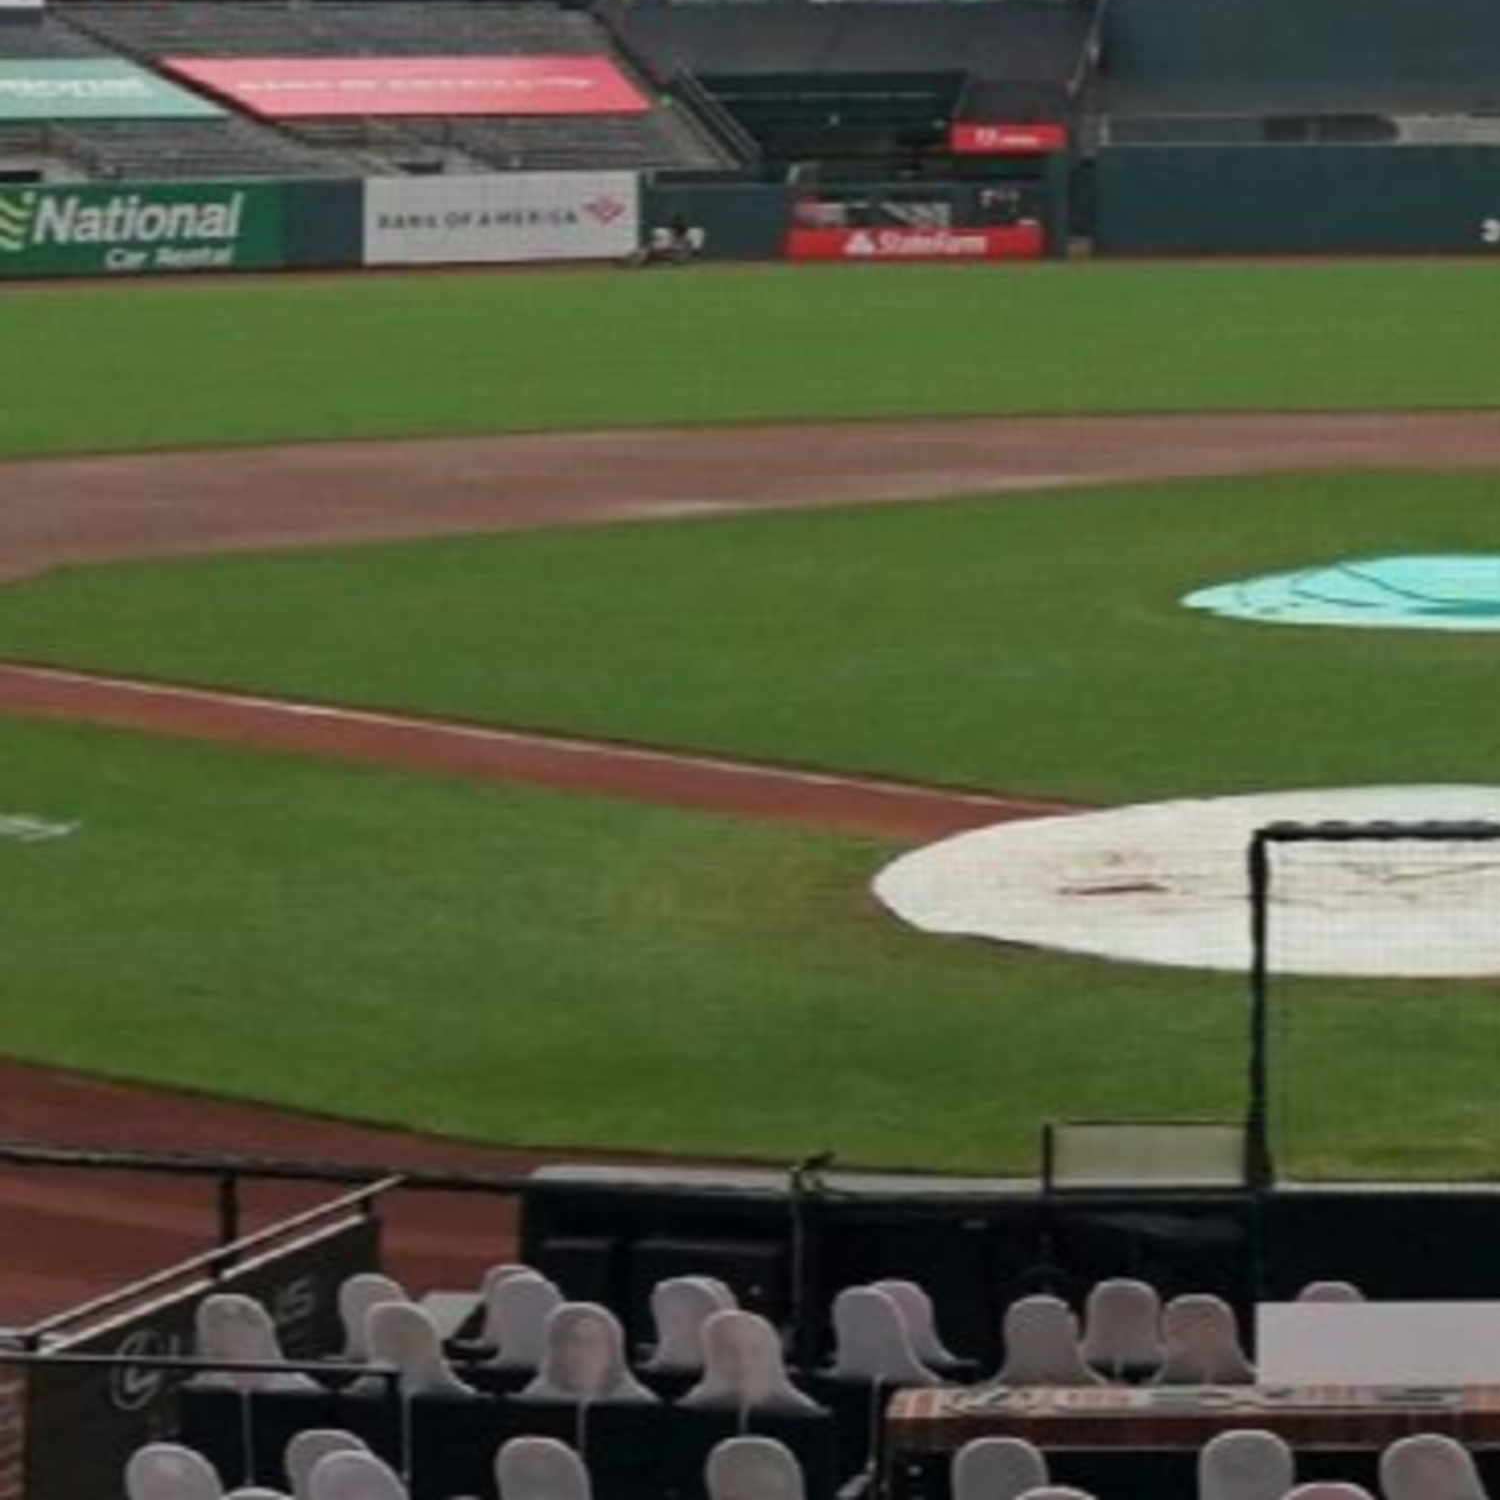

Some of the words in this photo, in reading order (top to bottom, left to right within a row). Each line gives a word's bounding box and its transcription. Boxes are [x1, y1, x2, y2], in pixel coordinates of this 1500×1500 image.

[34, 192, 244, 243] National
[377, 214, 438, 230] BANK
[443, 211, 473, 230] OF
[478, 209, 579, 228] AMERICA
[106, 249, 149, 269] Car
[155, 246, 234, 268] Rental
